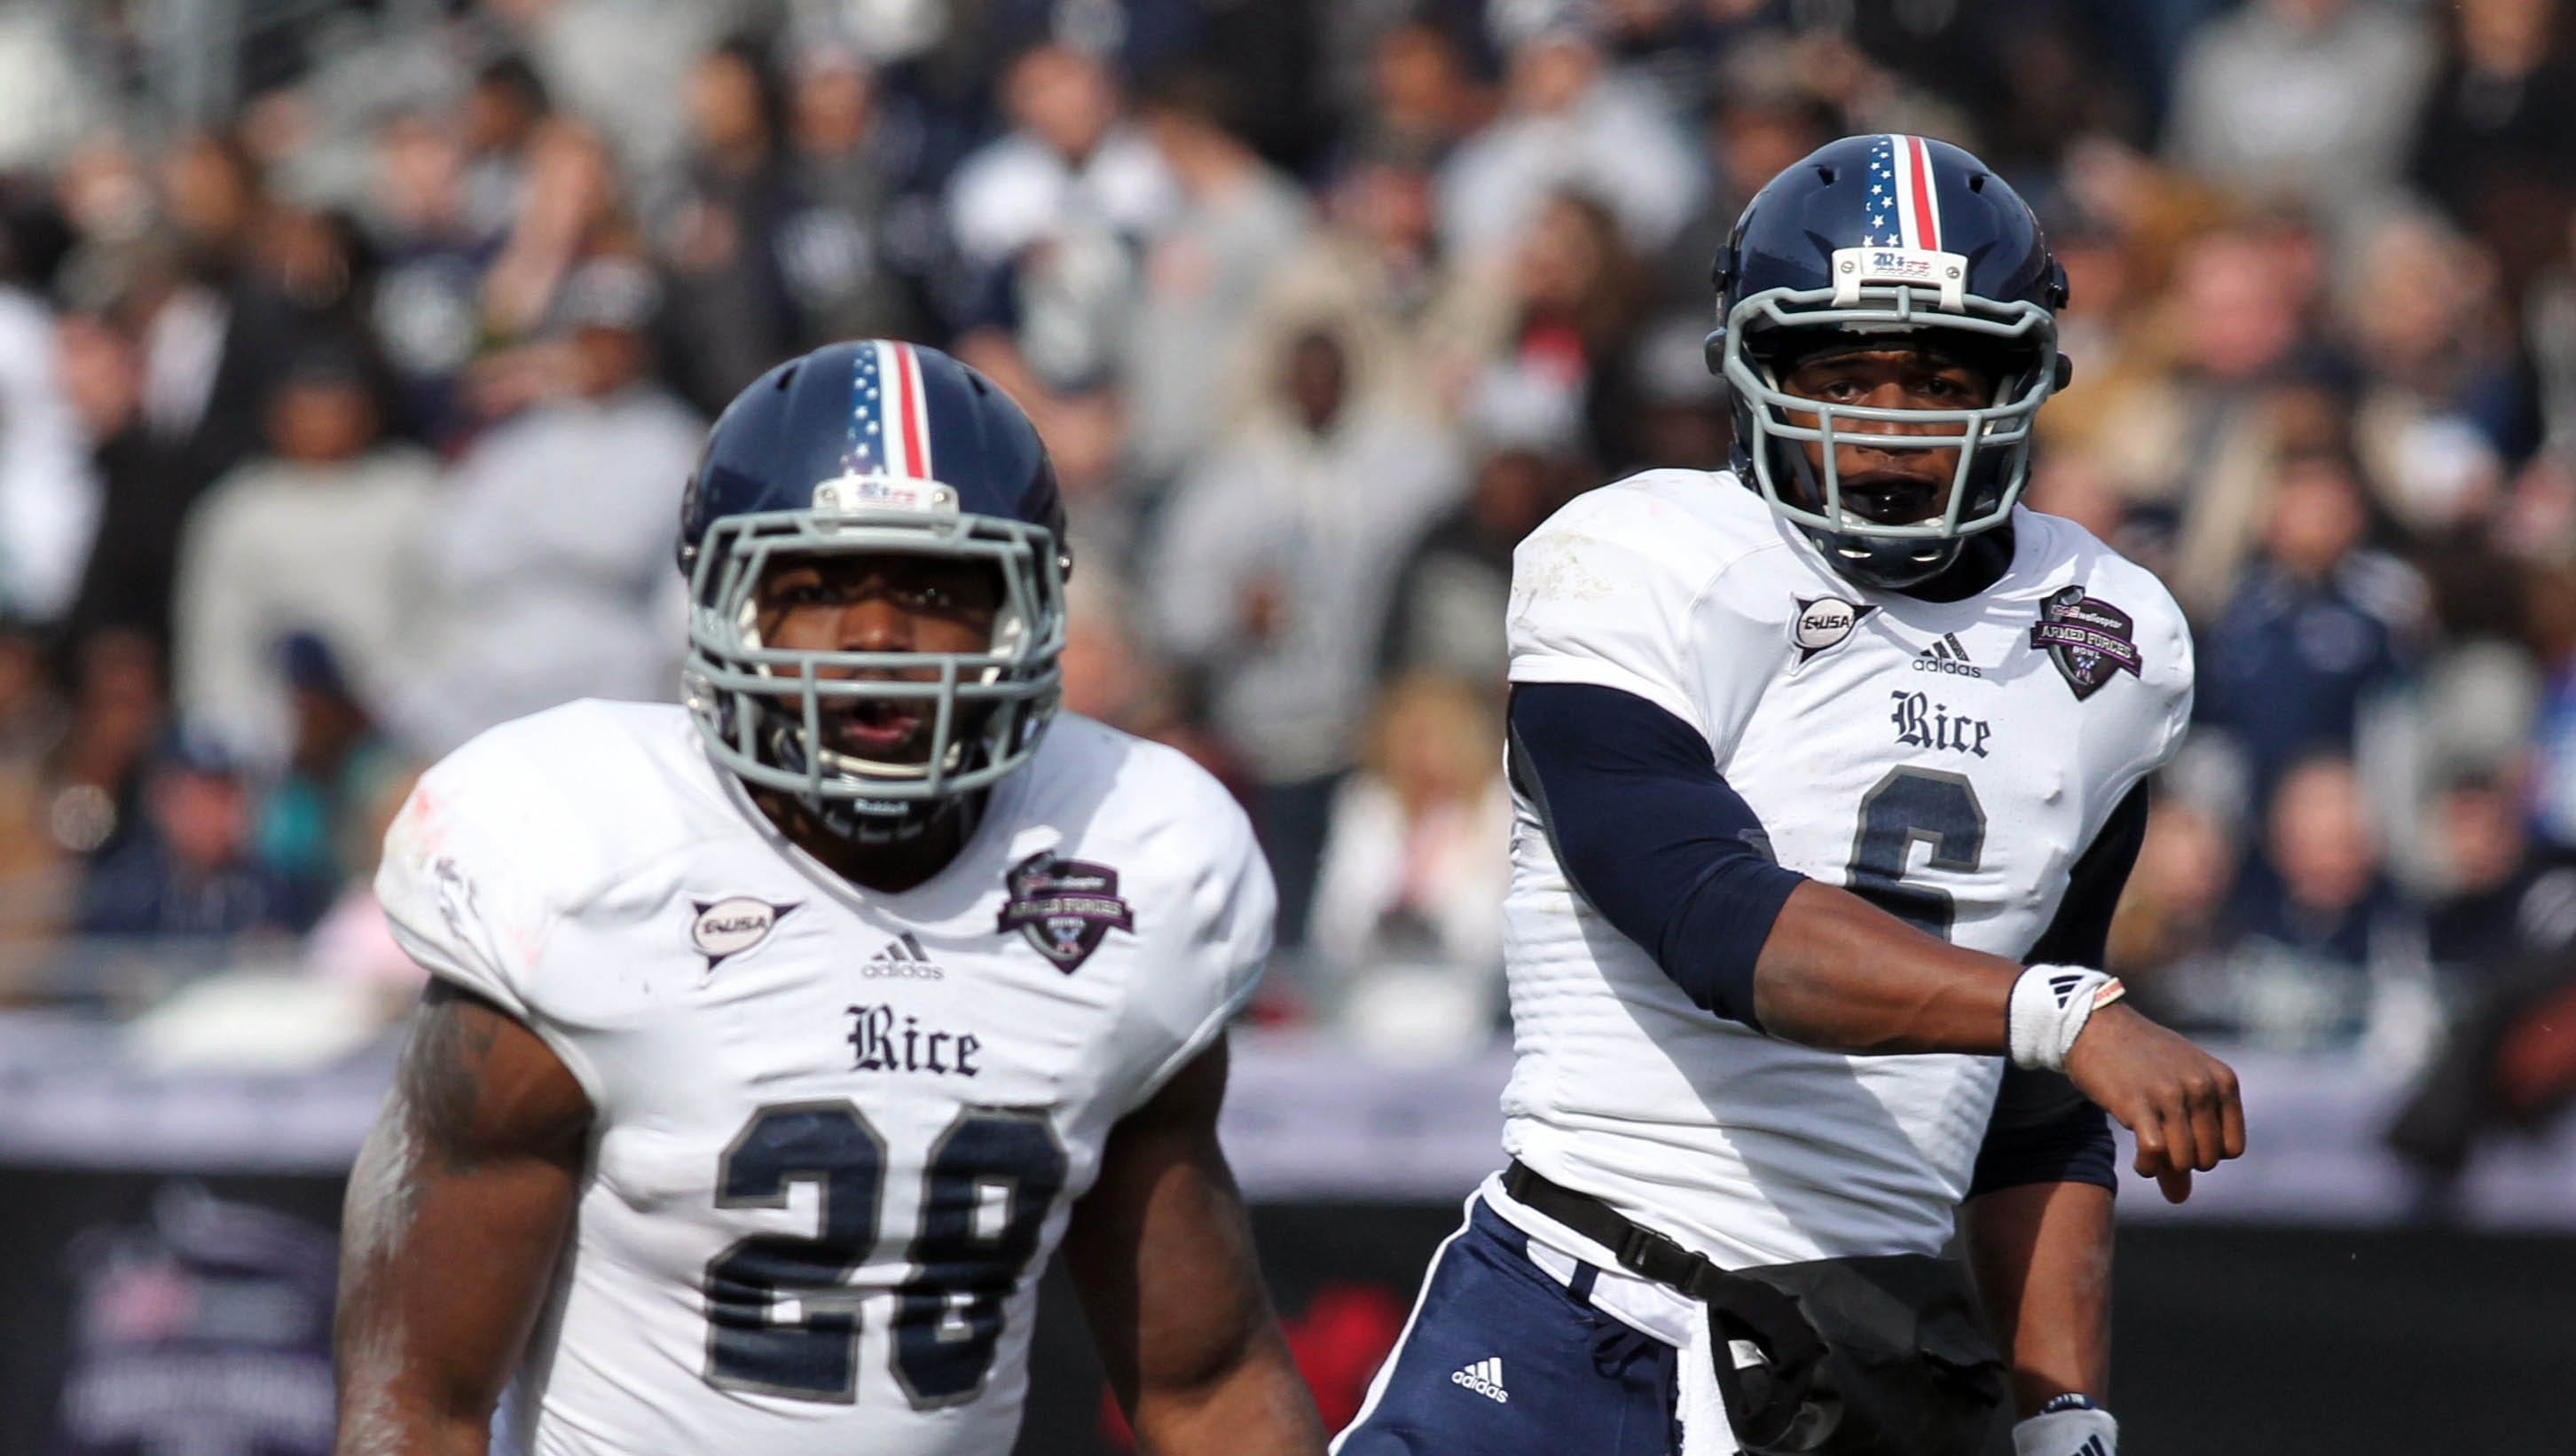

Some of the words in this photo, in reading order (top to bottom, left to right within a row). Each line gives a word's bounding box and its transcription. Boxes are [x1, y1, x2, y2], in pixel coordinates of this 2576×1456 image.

[2041, 625, 2085, 641] ARMED
[2086, 632, 2132, 658] FORCES
[2072, 645, 2101, 659] BOWL
[1912, 655, 1982, 679] adidas
[1890, 689, 1991, 759] Rice
[1843, 764, 1988, 942] 6
[861, 960, 945, 980] adidas
[844, 1003, 981, 1077] Rice
[704, 1098, 1069, 1412] 28
[1451, 1371, 1509, 1404] adidas
